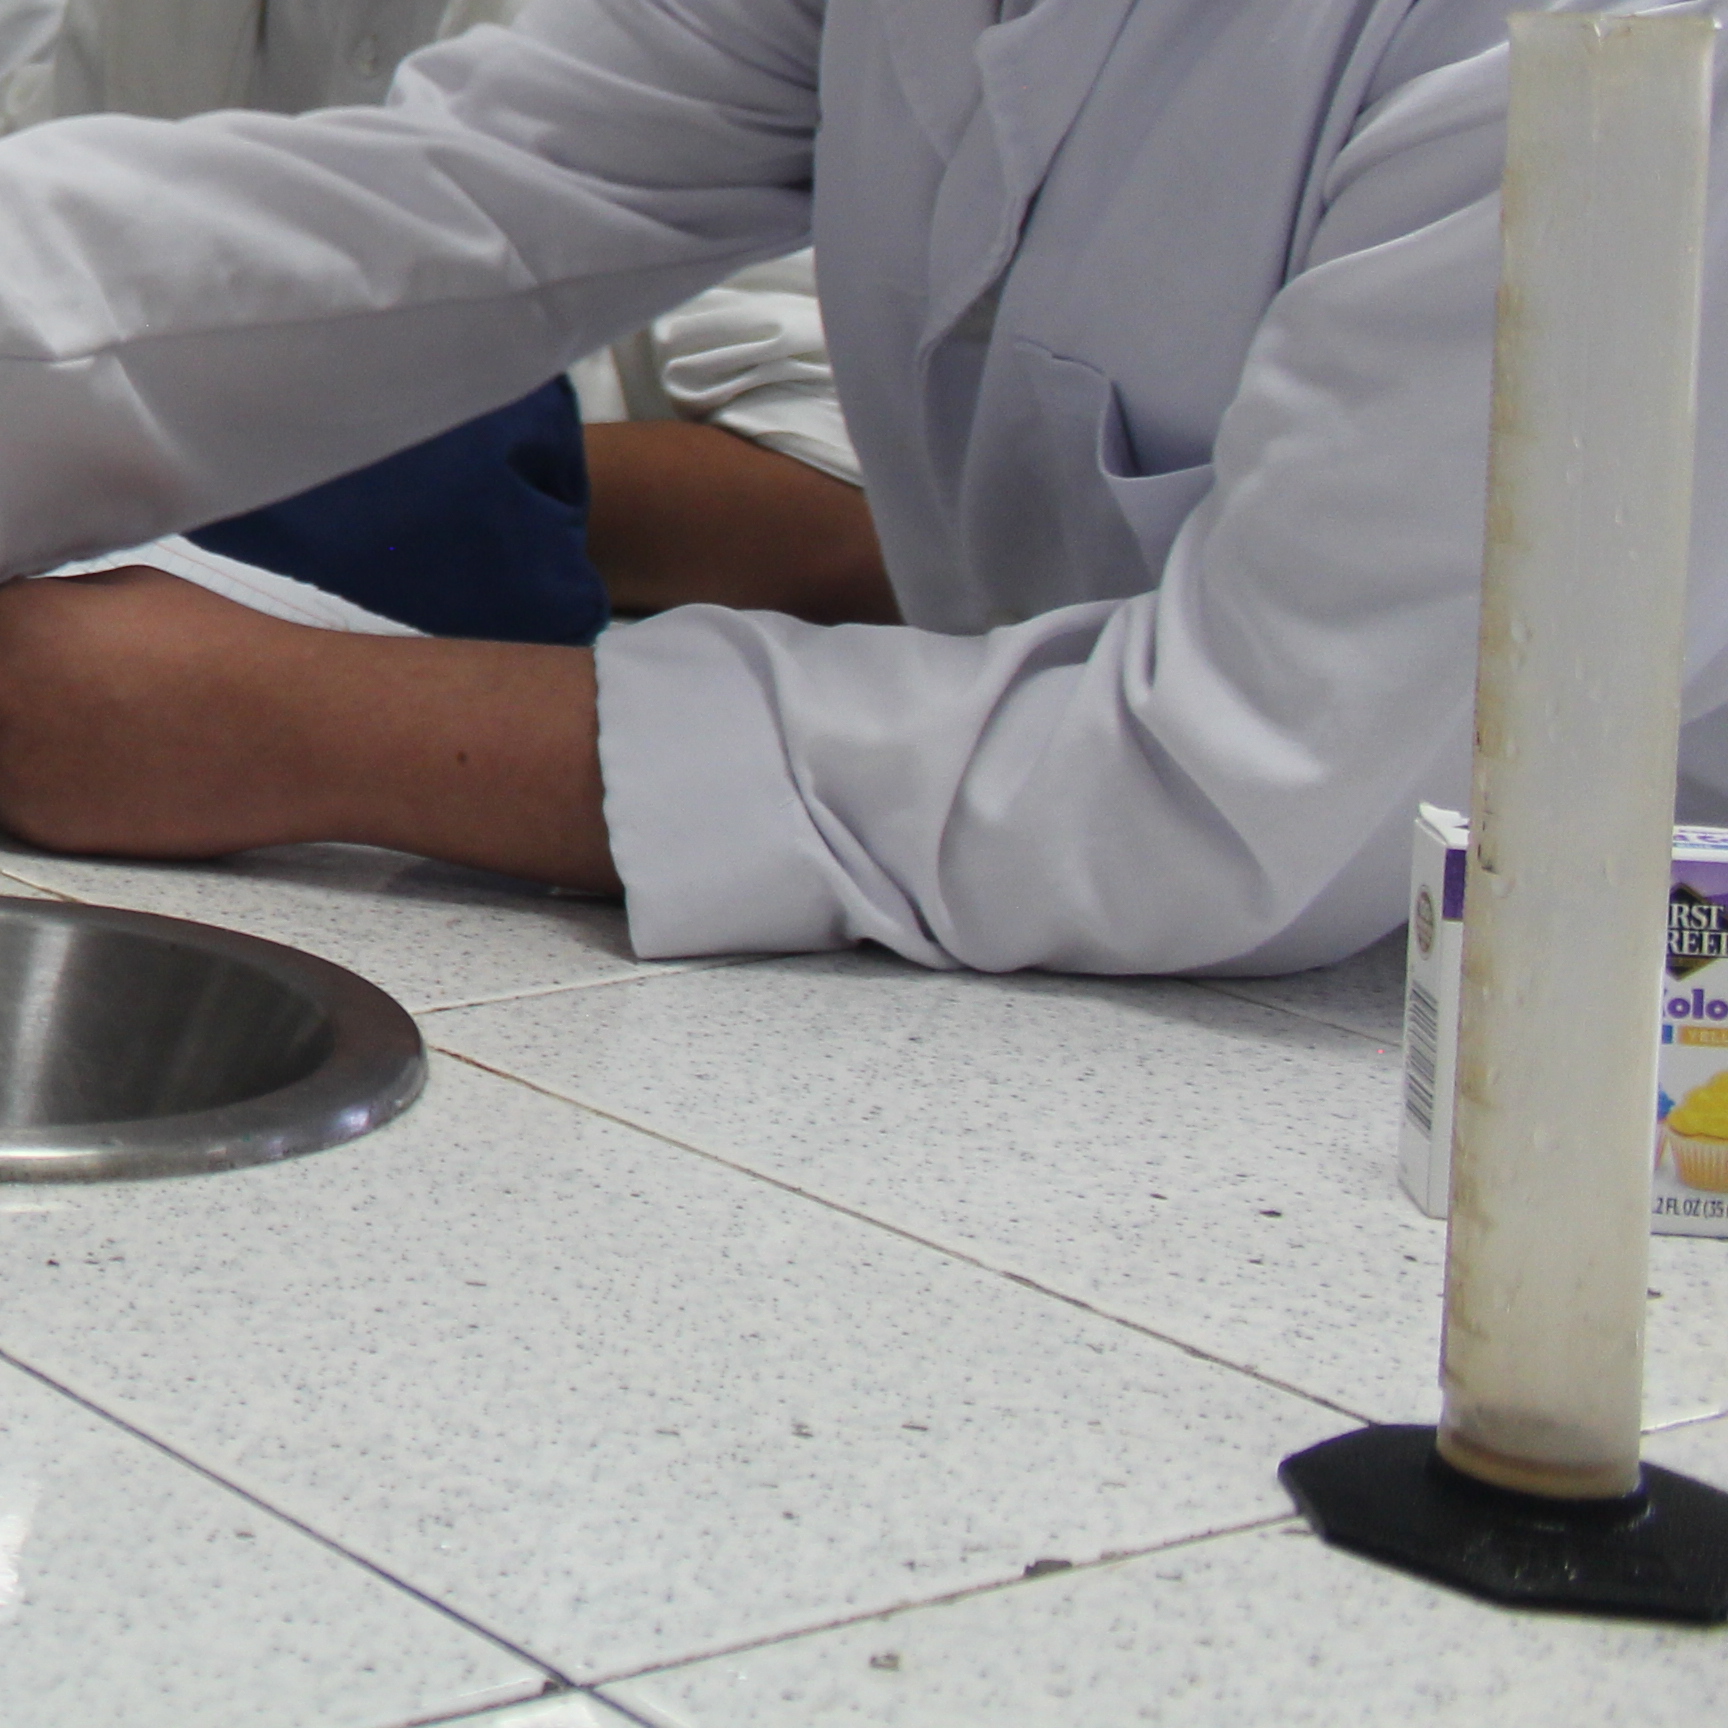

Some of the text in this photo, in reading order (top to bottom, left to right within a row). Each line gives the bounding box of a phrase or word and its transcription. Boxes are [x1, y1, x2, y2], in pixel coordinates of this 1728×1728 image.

[1669, 902, 1725, 930] RST
[1663, 987, 1728, 1021] olo
[1666, 1197, 1680, 1216] FL
[1683, 1198, 1701, 1218] OZ
